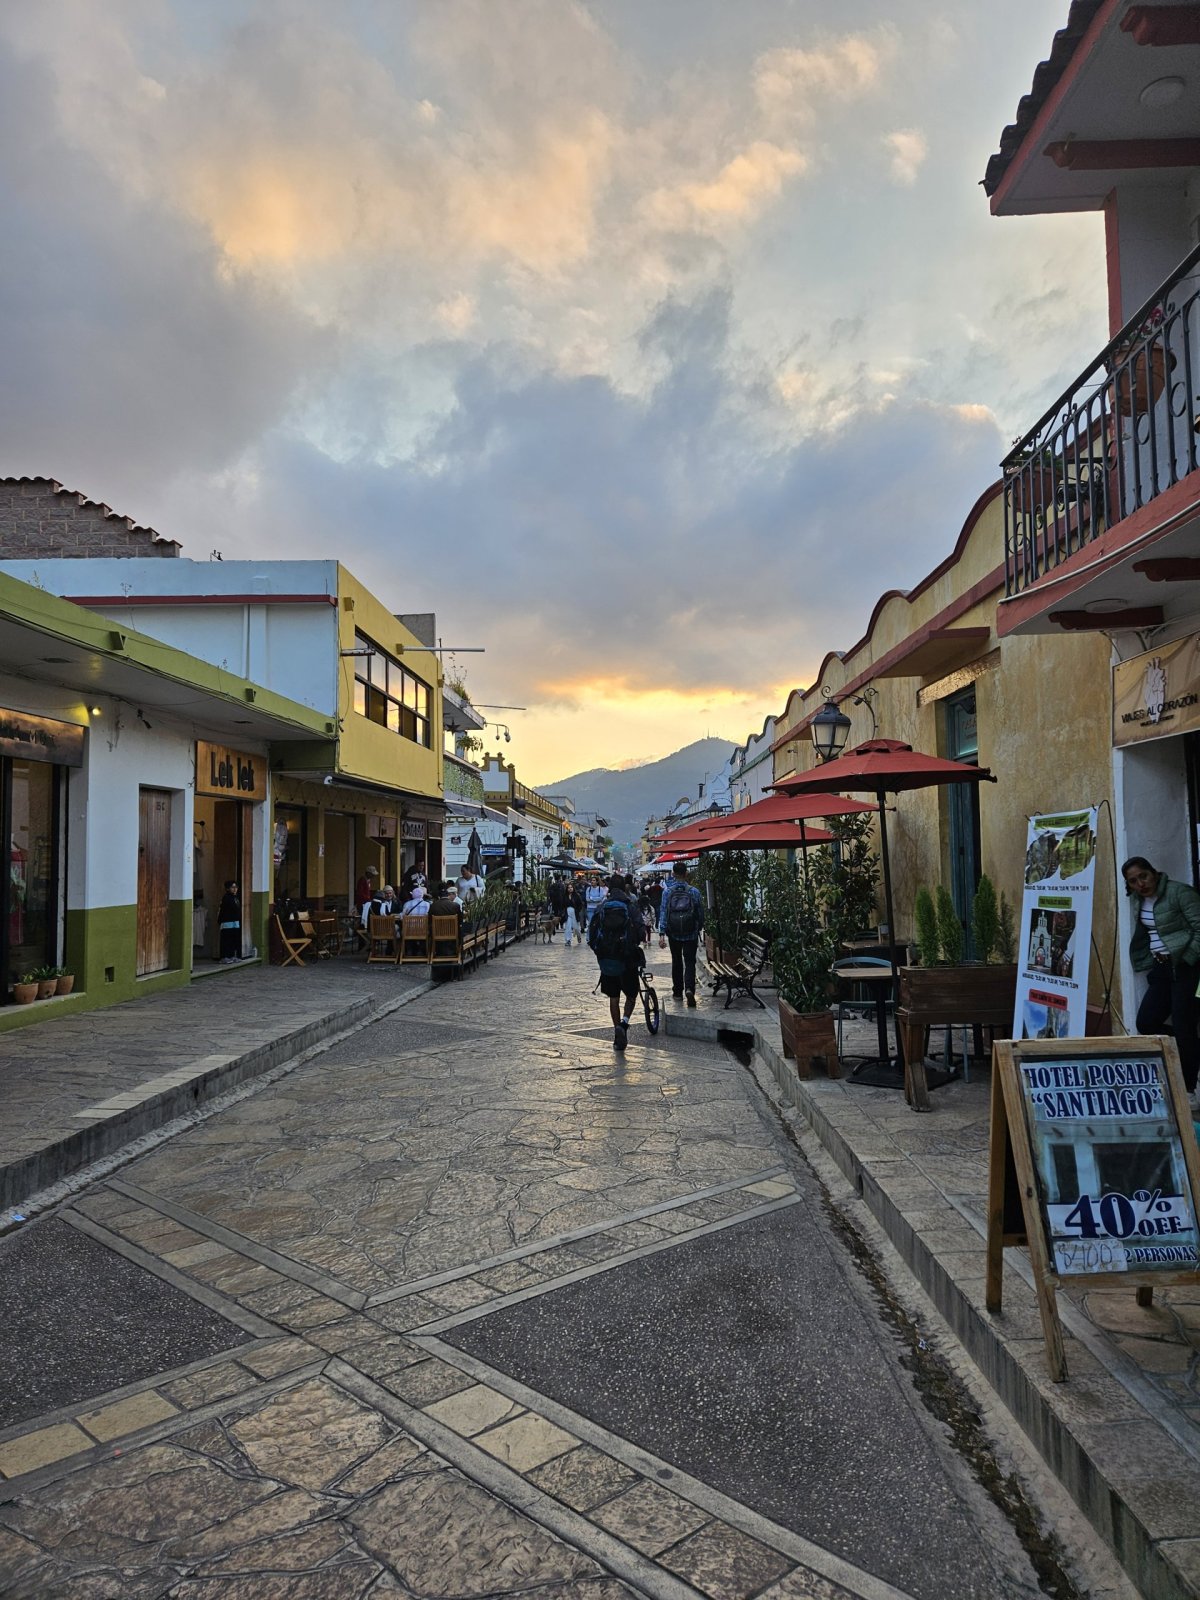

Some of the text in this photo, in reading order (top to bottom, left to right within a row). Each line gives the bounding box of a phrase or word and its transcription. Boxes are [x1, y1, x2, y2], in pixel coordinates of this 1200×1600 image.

[1147, 706, 1156, 716] AL
[1157, 692, 1198, 713] CORAZÓN
[1024, 1063, 1165, 1089] HOTEL POSADA
[1065, 1189, 1181, 1239] 40% OFF
[1124, 1246, 1198, 1263] 2 PERSONAS
